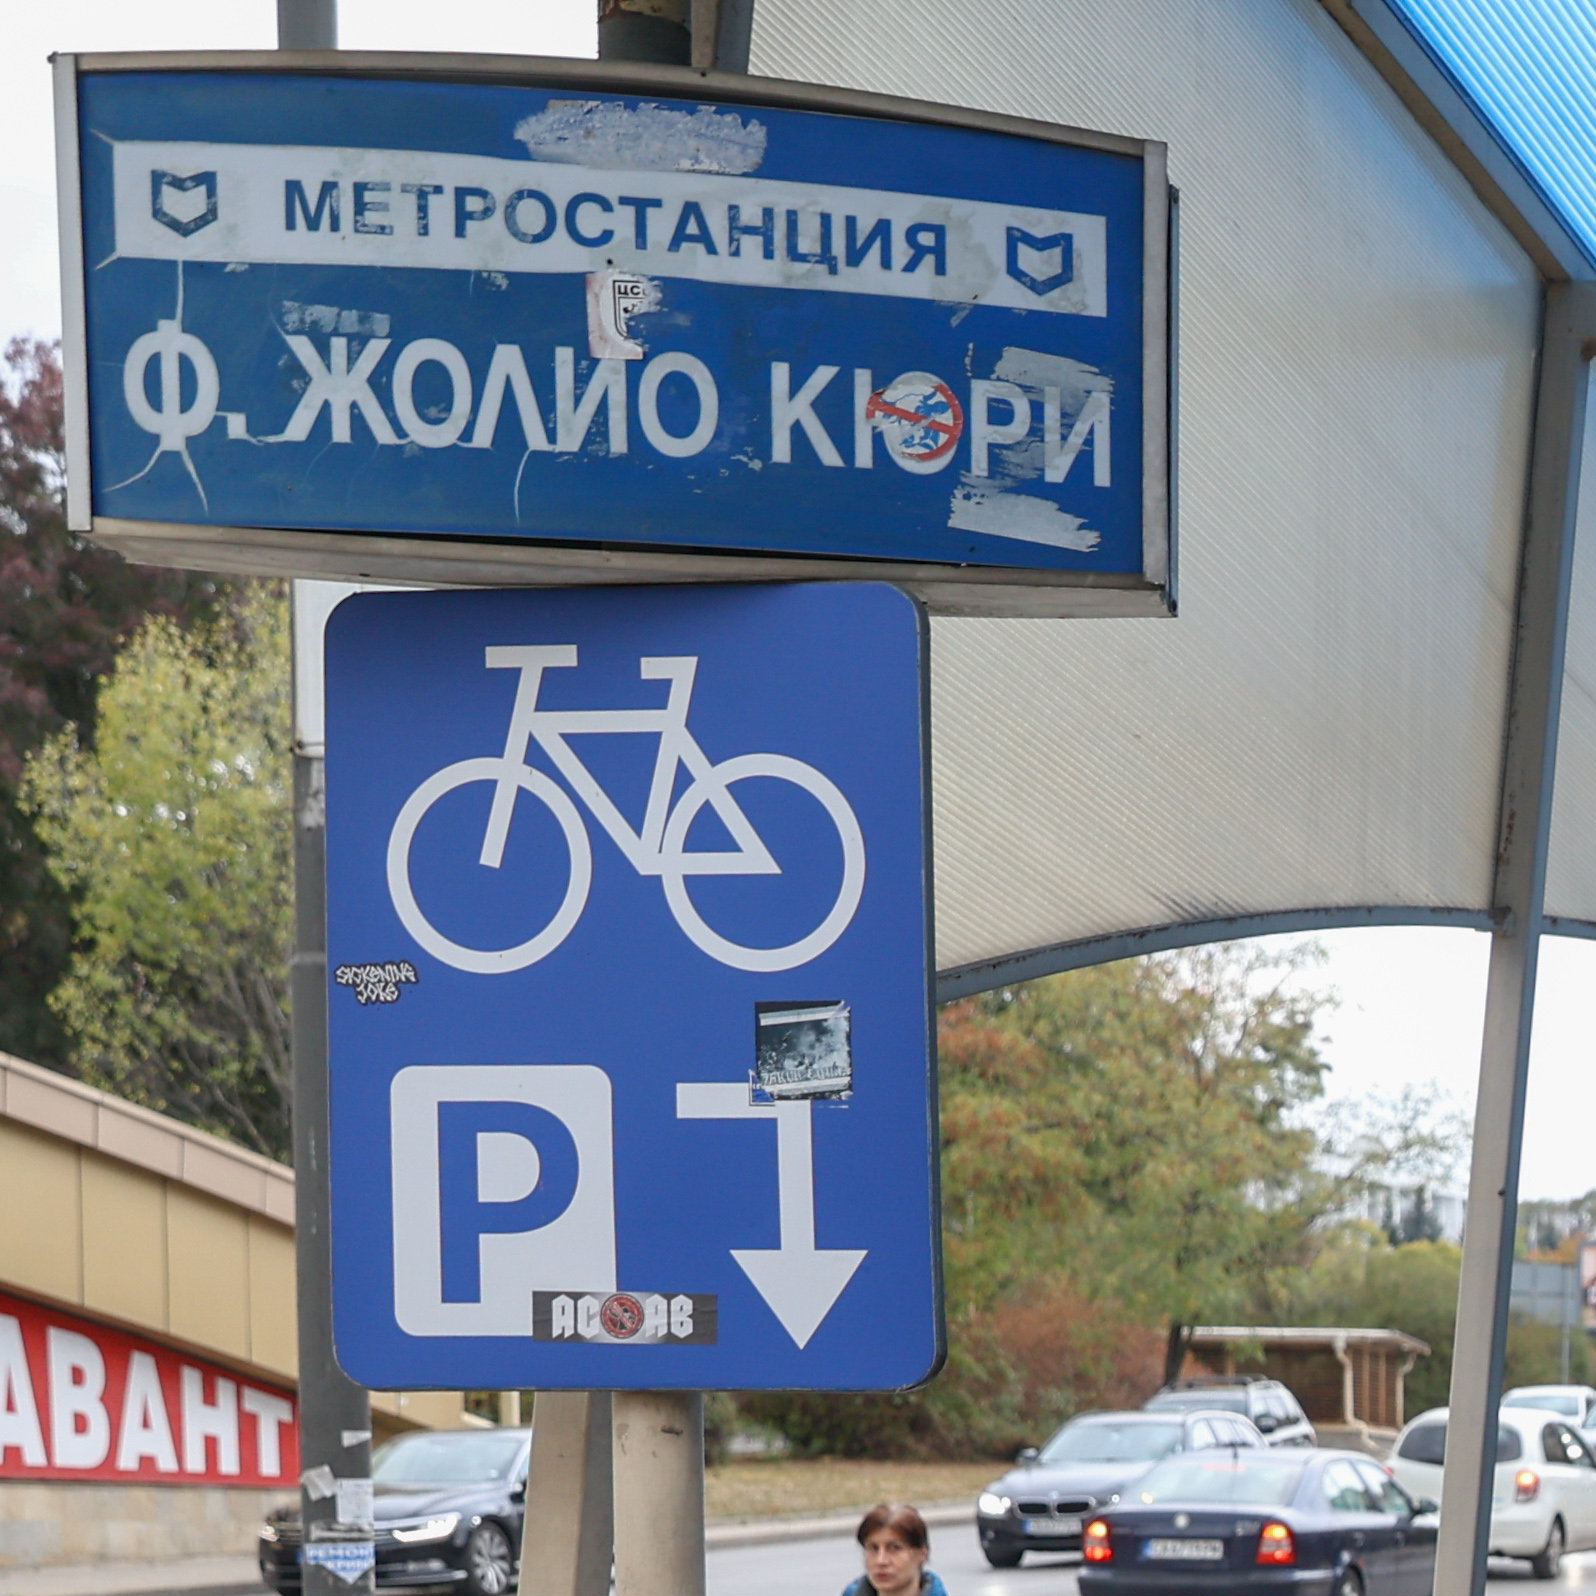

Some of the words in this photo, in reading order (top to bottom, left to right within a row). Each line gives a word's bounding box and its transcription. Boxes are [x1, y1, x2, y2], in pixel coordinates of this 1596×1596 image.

[283, 178, 948, 276] МЕТРОСТАНЦИЯ
[282, 337, 718, 459] ЖОЛИО
[437, 1101, 580, 1304] P
